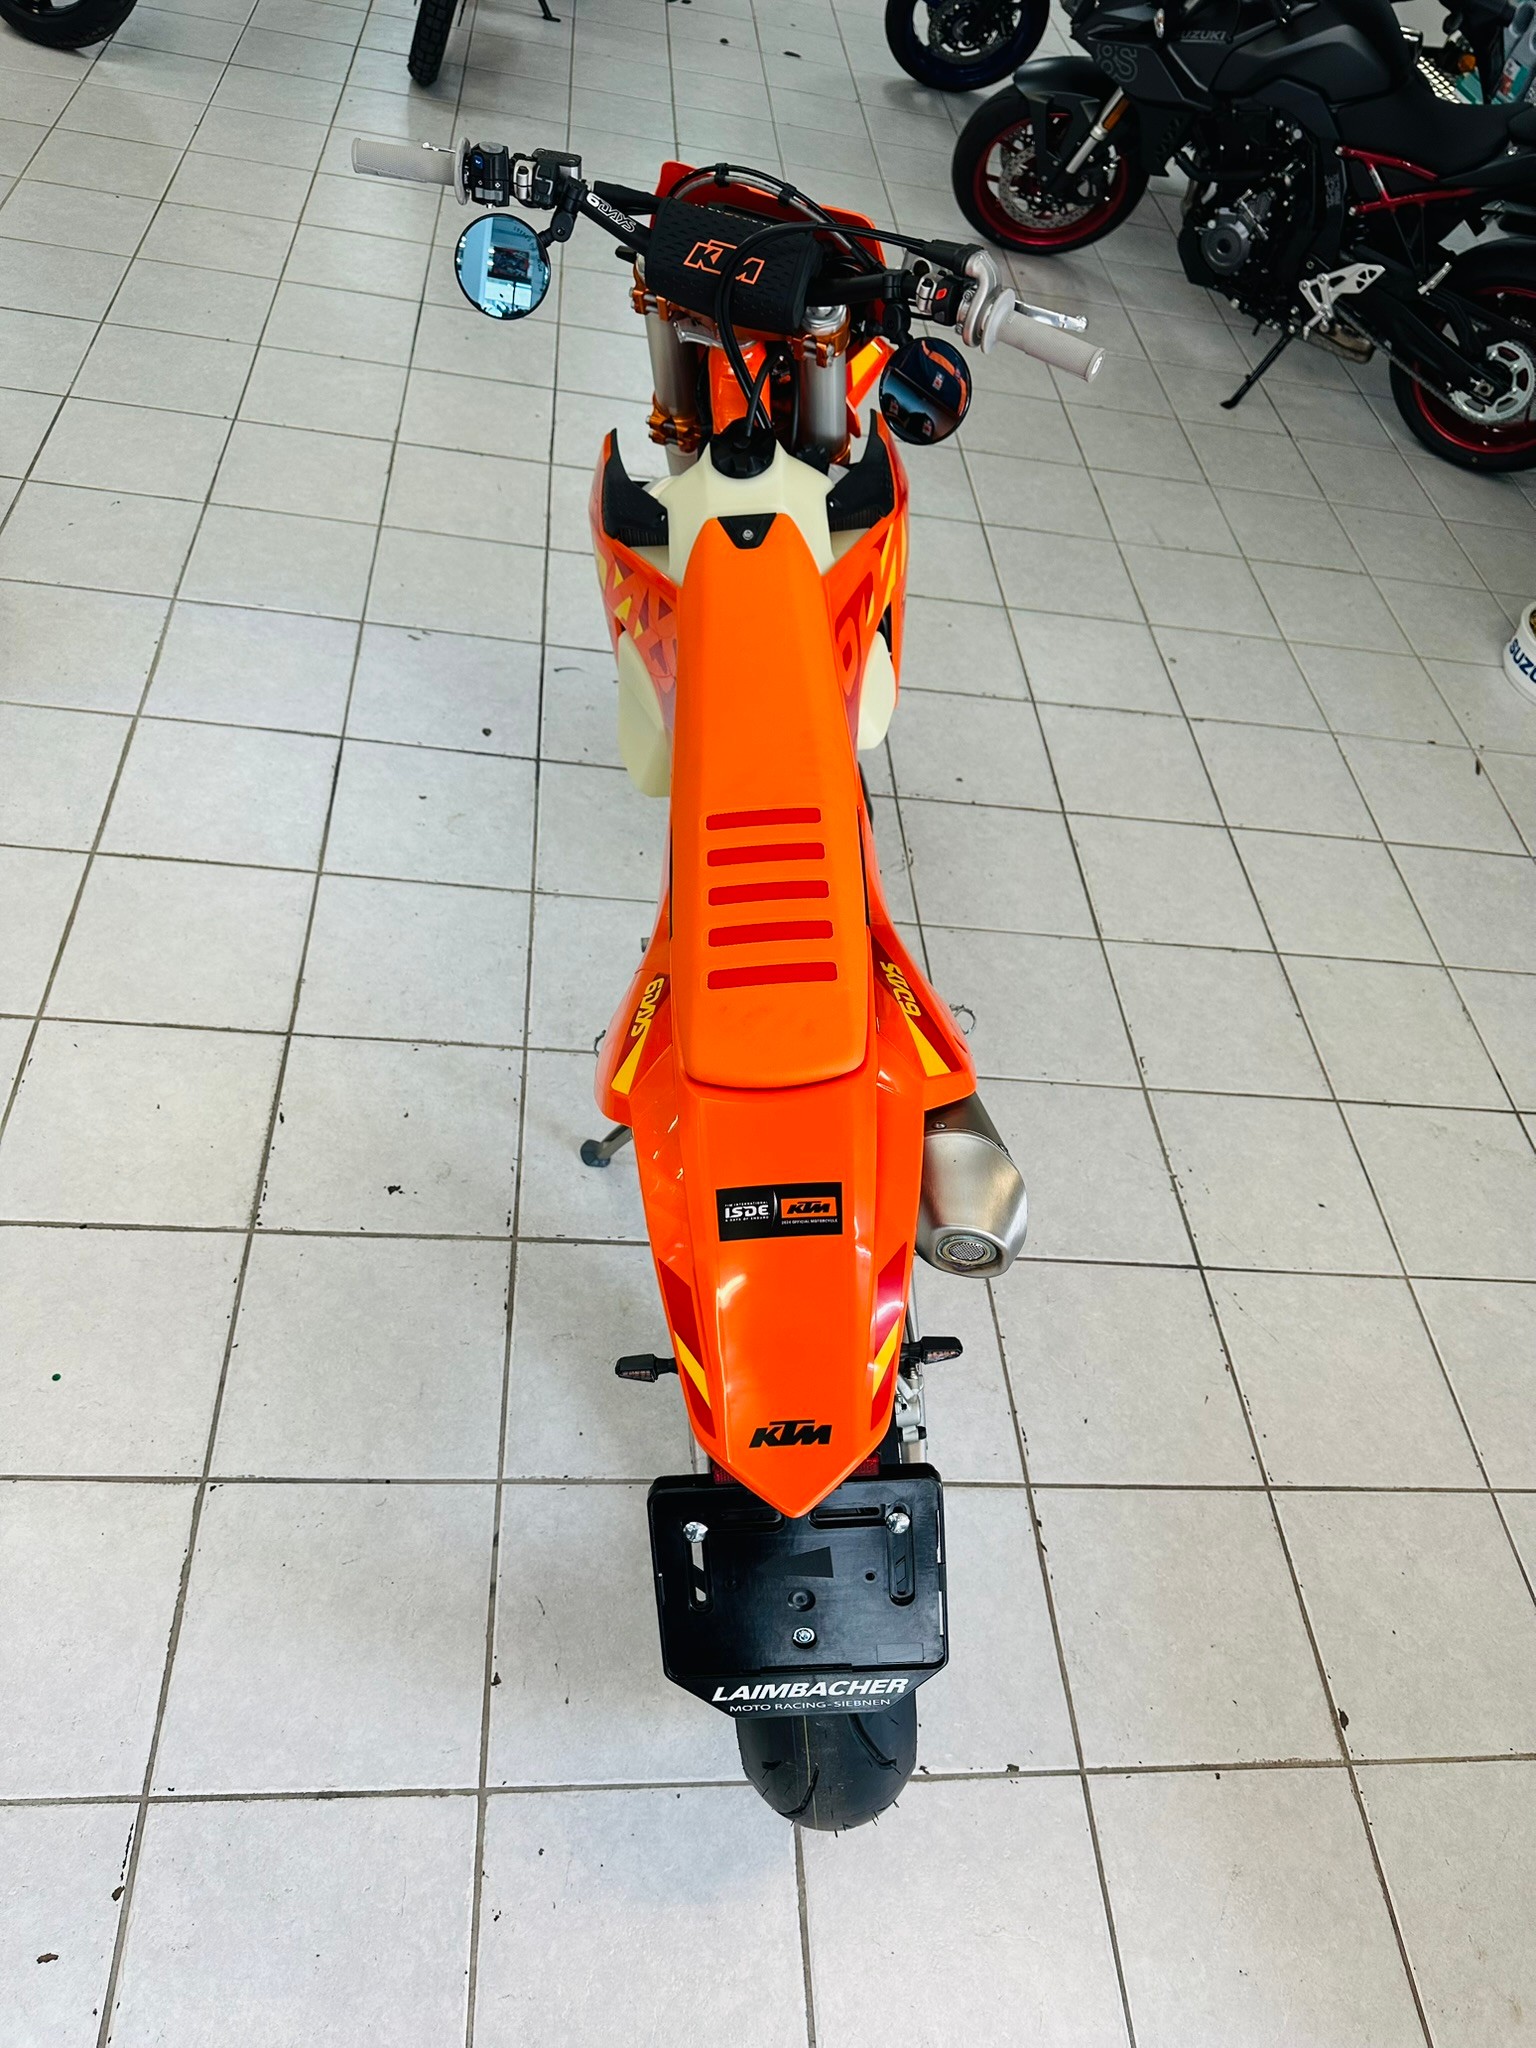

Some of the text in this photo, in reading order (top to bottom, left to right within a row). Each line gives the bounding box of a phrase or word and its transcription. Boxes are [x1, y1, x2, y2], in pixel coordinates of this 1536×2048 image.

[586, 192, 636, 233] 6DAYS
[879, 961, 921, 1017] 6DAYS
[631, 977, 665, 1037] 6DAYS
[725, 1204, 769, 1219] ISDE
[787, 1201, 830, 1214] KTM
[749, 1419, 832, 1448] KTM
[711, 1678, 909, 1702] LAIMBACHER
[729, 1703, 771, 1713] MOTO
